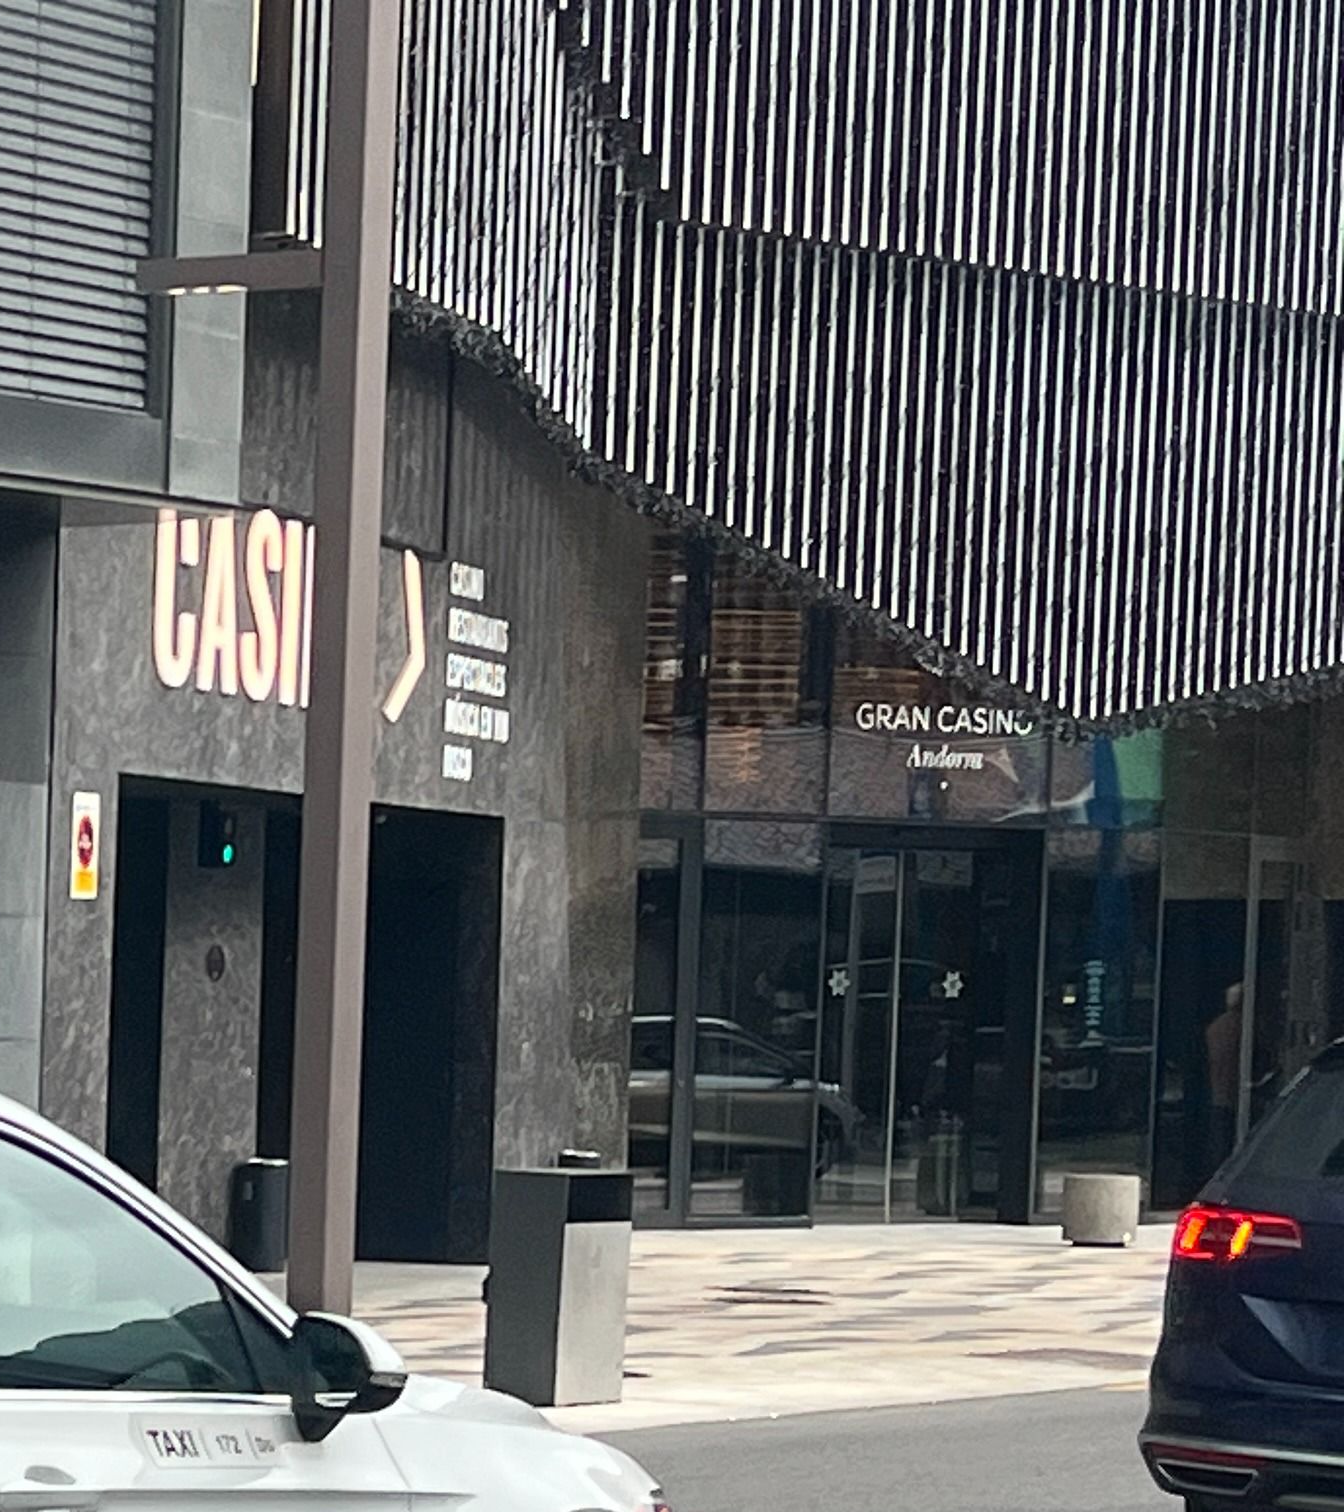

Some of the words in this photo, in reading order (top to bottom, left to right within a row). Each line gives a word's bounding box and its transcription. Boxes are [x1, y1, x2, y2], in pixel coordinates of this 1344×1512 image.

[154, 508, 315, 709] CASI
[856, 703, 931, 731] GRAN
[146, 1430, 200, 1457] TAXI
